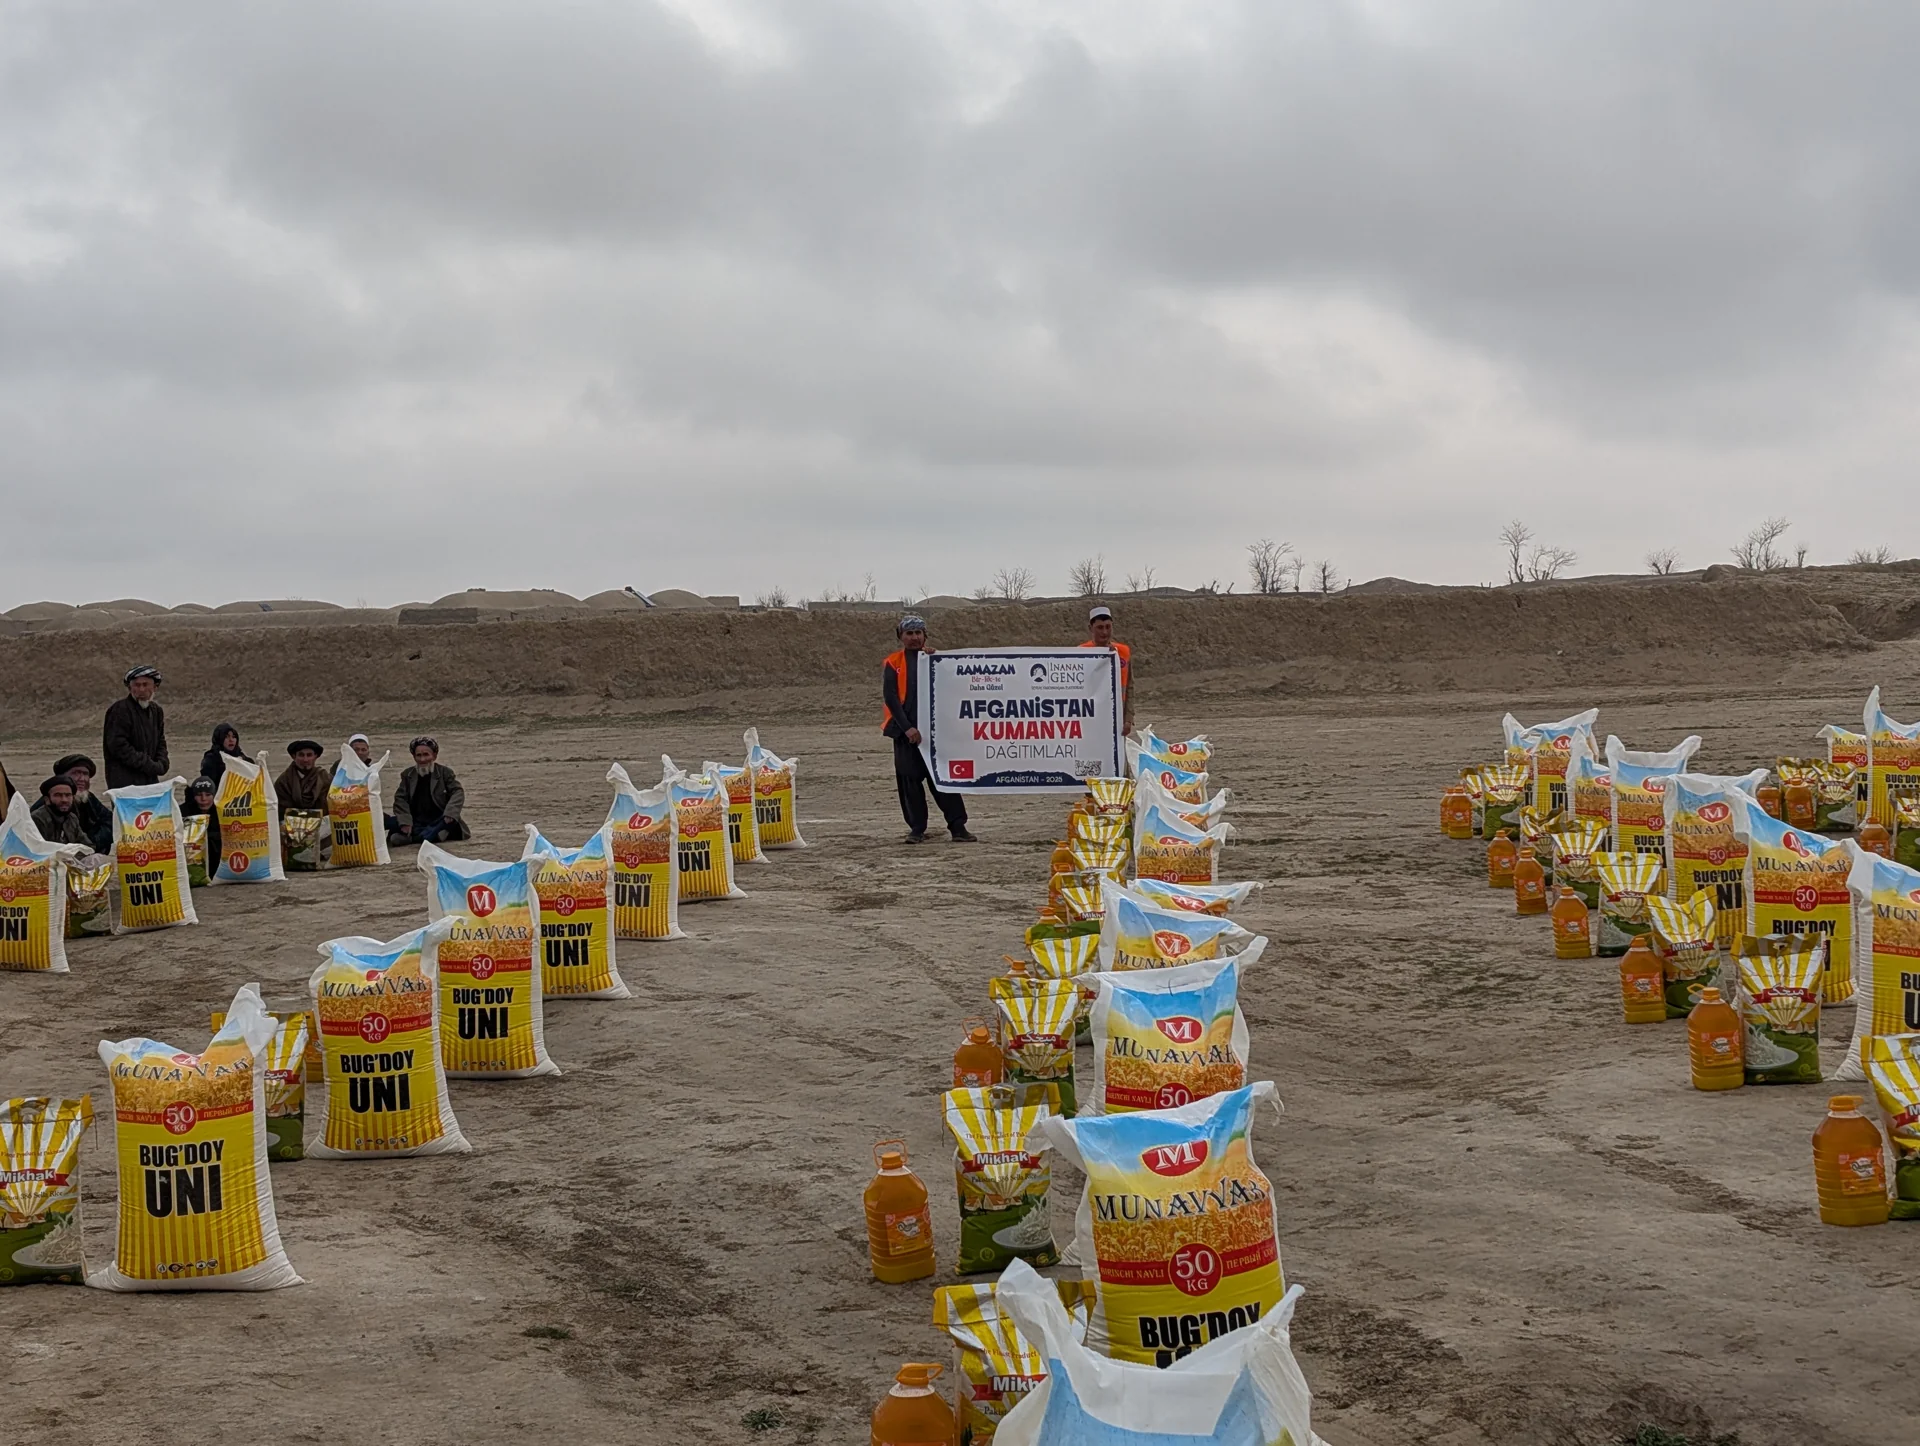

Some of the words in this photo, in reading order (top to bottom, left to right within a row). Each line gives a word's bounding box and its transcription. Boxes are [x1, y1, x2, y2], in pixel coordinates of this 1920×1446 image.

[956, 664, 1016, 676] RAMAZAN
[1050, 672, 1085, 684] GENÇ
[973, 720, 1082, 740] KUMANYA
[985, 742, 1077, 759] DAĞITIMLARI
[1855, 755, 1867, 763] 50
[1898, 759, 1911, 767] 50
[755, 806, 782, 824] UNI
[1703, 807, 1722, 818] M
[686, 825, 698, 834] 50
[1648, 817, 1662, 827] 50
[335, 829, 360, 846] UNI
[1633, 835, 1665, 846] BUG'D
[135, 852, 148, 861] 50
[232, 856, 245, 869] M
[625, 855, 639, 864] 50
[678, 850, 711, 873] UNI
[1708, 850, 1725, 860] 50
[1757, 857, 1847, 873] MUNAVVAR
[125, 871, 164, 883] BUG'DOY
[614, 873, 653, 884] BUG'DOY
[1163, 872, 1178, 882] 50
[1694, 869, 1744, 883] BUG'DOY
[2, 889, 15, 898] 50
[130, 883, 163, 906] UNI
[614, 885, 650, 907] UNI
[1795, 889, 1816, 902] 50
[557, 896, 575, 908] 50
[0, 906, 30, 918] G'DOY
[450, 925, 528, 941] UNAVVAR
[540, 922, 593, 938] BUG'DOY
[545, 939, 589, 967] UNI
[472, 957, 492, 971] 50
[476, 970, 488, 978] KG
[322, 976, 427, 997] MUNAVVAR
[452, 987, 514, 1005] BUG'DOY
[362, 1016, 386, 1033] 50
[458, 1007, 509, 1040] UNI
[1164, 1021, 1193, 1039] M
[340, 1049, 414, 1074] BUG'DOY
[348, 1073, 411, 1114] UNI
[1159, 1087, 1189, 1108] 50
[166, 1105, 194, 1125] 50
[139, 1140, 225, 1167] BUG'DOY
[976, 1152, 1028, 1165] Mikhak
[1155, 1142, 1200, 1171] M
[0, 1170, 54, 1183] Mikhak
[144, 1164, 223, 1218] UNI
[1093, 1176, 1266, 1222] MUNAVVAR
[1175, 1250, 1214, 1280] 50
[1226, 1254, 1261, 1270] ПЕРВЫЙ
[1100, 1267, 1134, 1279] BIRINCHI
[1136, 1269, 1165, 1279] NAVLI
[1187, 1278, 1209, 1292] KG
[1138, 1301, 1261, 1348] BUG'DOY
[993, 1376, 1039, 1392] Mikh
